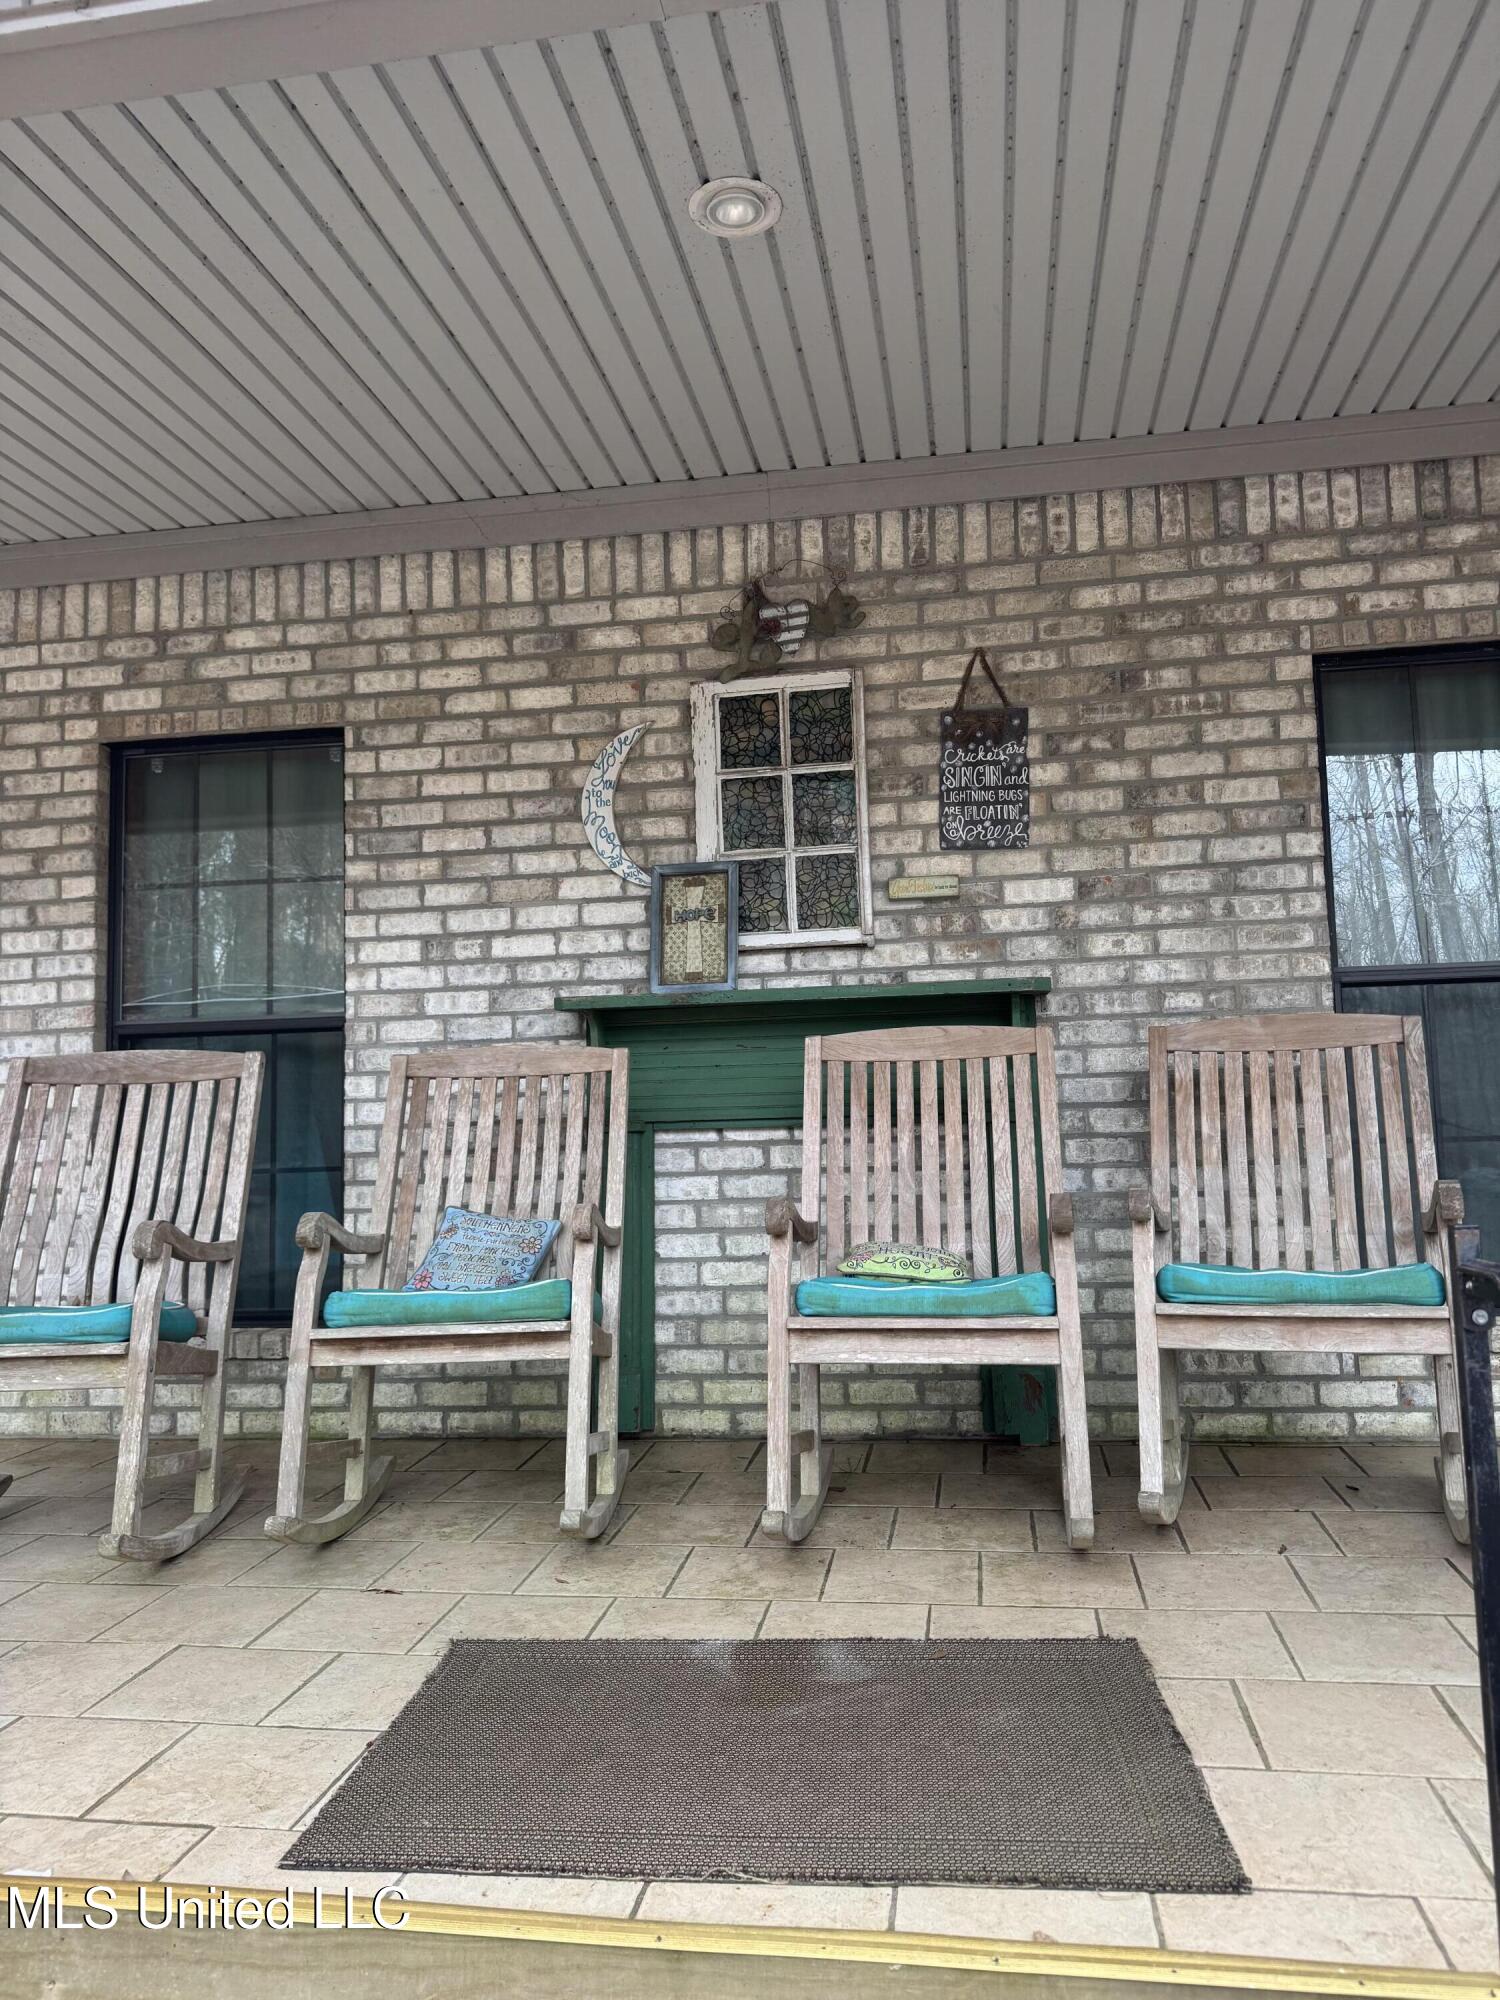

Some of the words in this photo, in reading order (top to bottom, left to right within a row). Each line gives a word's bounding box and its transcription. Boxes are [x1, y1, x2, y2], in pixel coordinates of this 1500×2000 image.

[944, 744, 1009, 763] Crickets
[1005, 742, 1025, 754] are
[1004, 767, 1029, 784] and
[592, 788, 602, 798] to
[944, 790, 995, 803] LIGHTNING
[998, 789, 1023, 801] BUGS
[596, 797, 611, 808] the
[943, 806, 961, 815] ARE
[954, 815, 1028, 846] breeze
